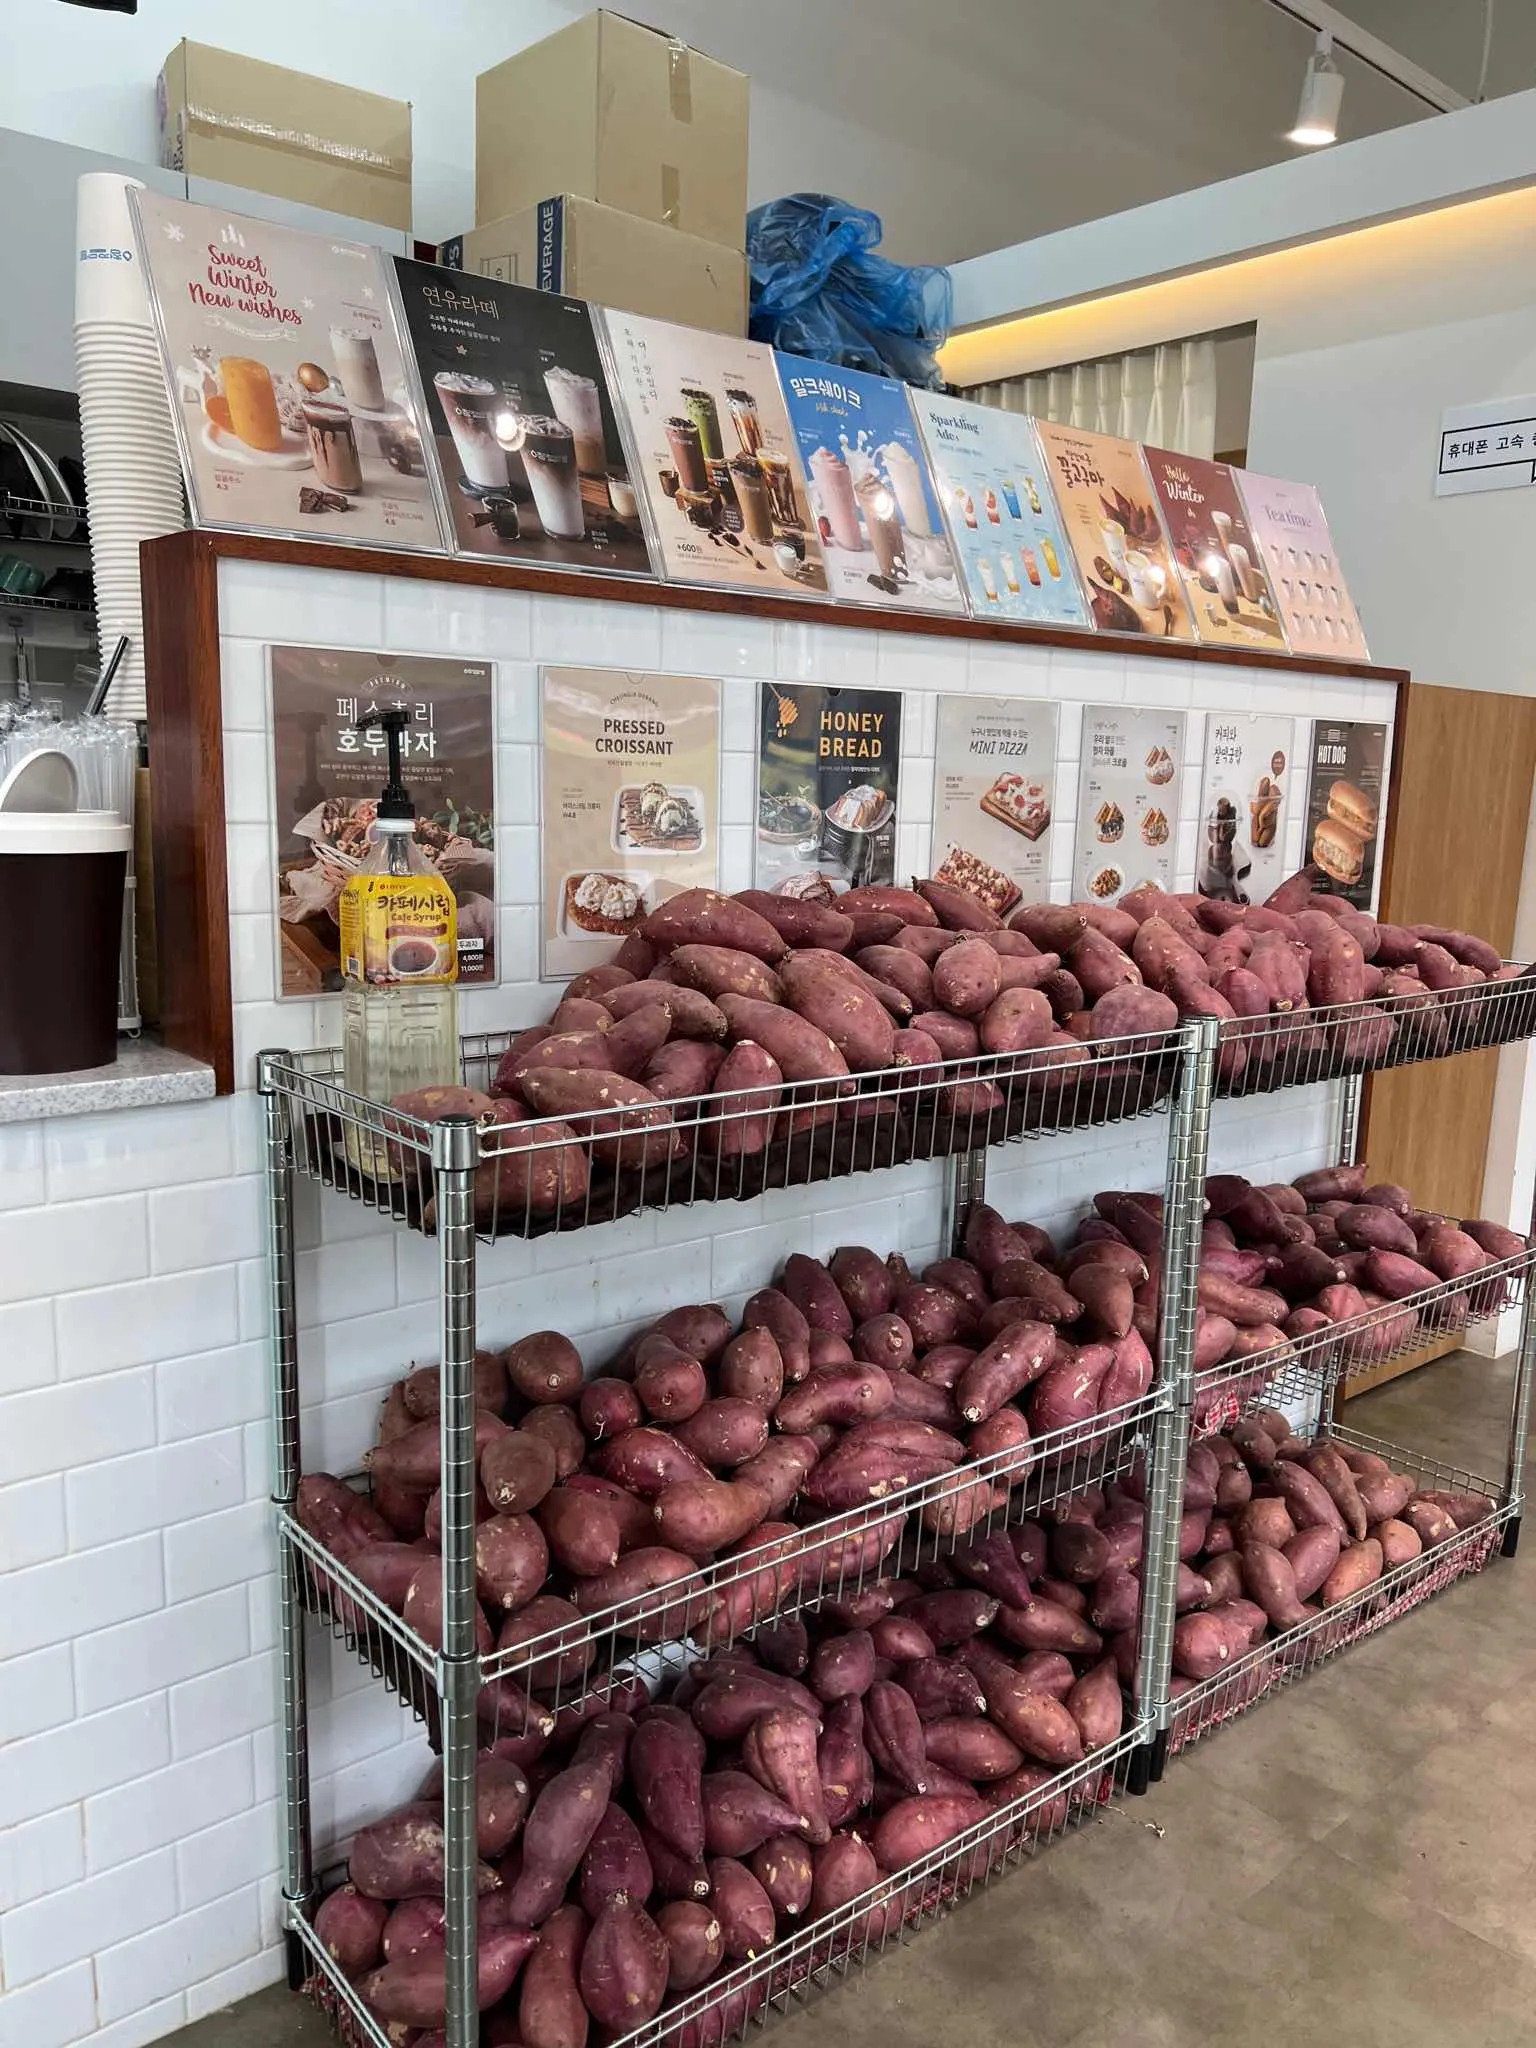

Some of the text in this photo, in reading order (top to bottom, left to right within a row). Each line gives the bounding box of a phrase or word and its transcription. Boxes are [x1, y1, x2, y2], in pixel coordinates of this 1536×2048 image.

[542, 203, 554, 292] EVERAGE
[208, 244, 267, 277] Sweet
[208, 266, 277, 298] Winter
[188, 282, 303, 324] New wishes
[423, 287, 499, 320] 연유라떼
[789, 378, 862, 409] 밀크쉐이크
[929, 412, 980, 435] Sparkling
[1447, 439, 1489, 459] 휴대폰
[1495, 433, 1524, 450] 고속
[1162, 480, 1205, 503] Winter
[603, 718, 665, 735] PRESSED
[820, 711, 884, 733] HONEY
[595, 738, 673, 755] CROISSANT
[819, 737, 882, 758] BREAD
[969, 740, 1029, 756] MINI PIZZA
[1317, 745, 1347, 764] HOT DOG
[378, 895, 450, 917] 카페시럽
